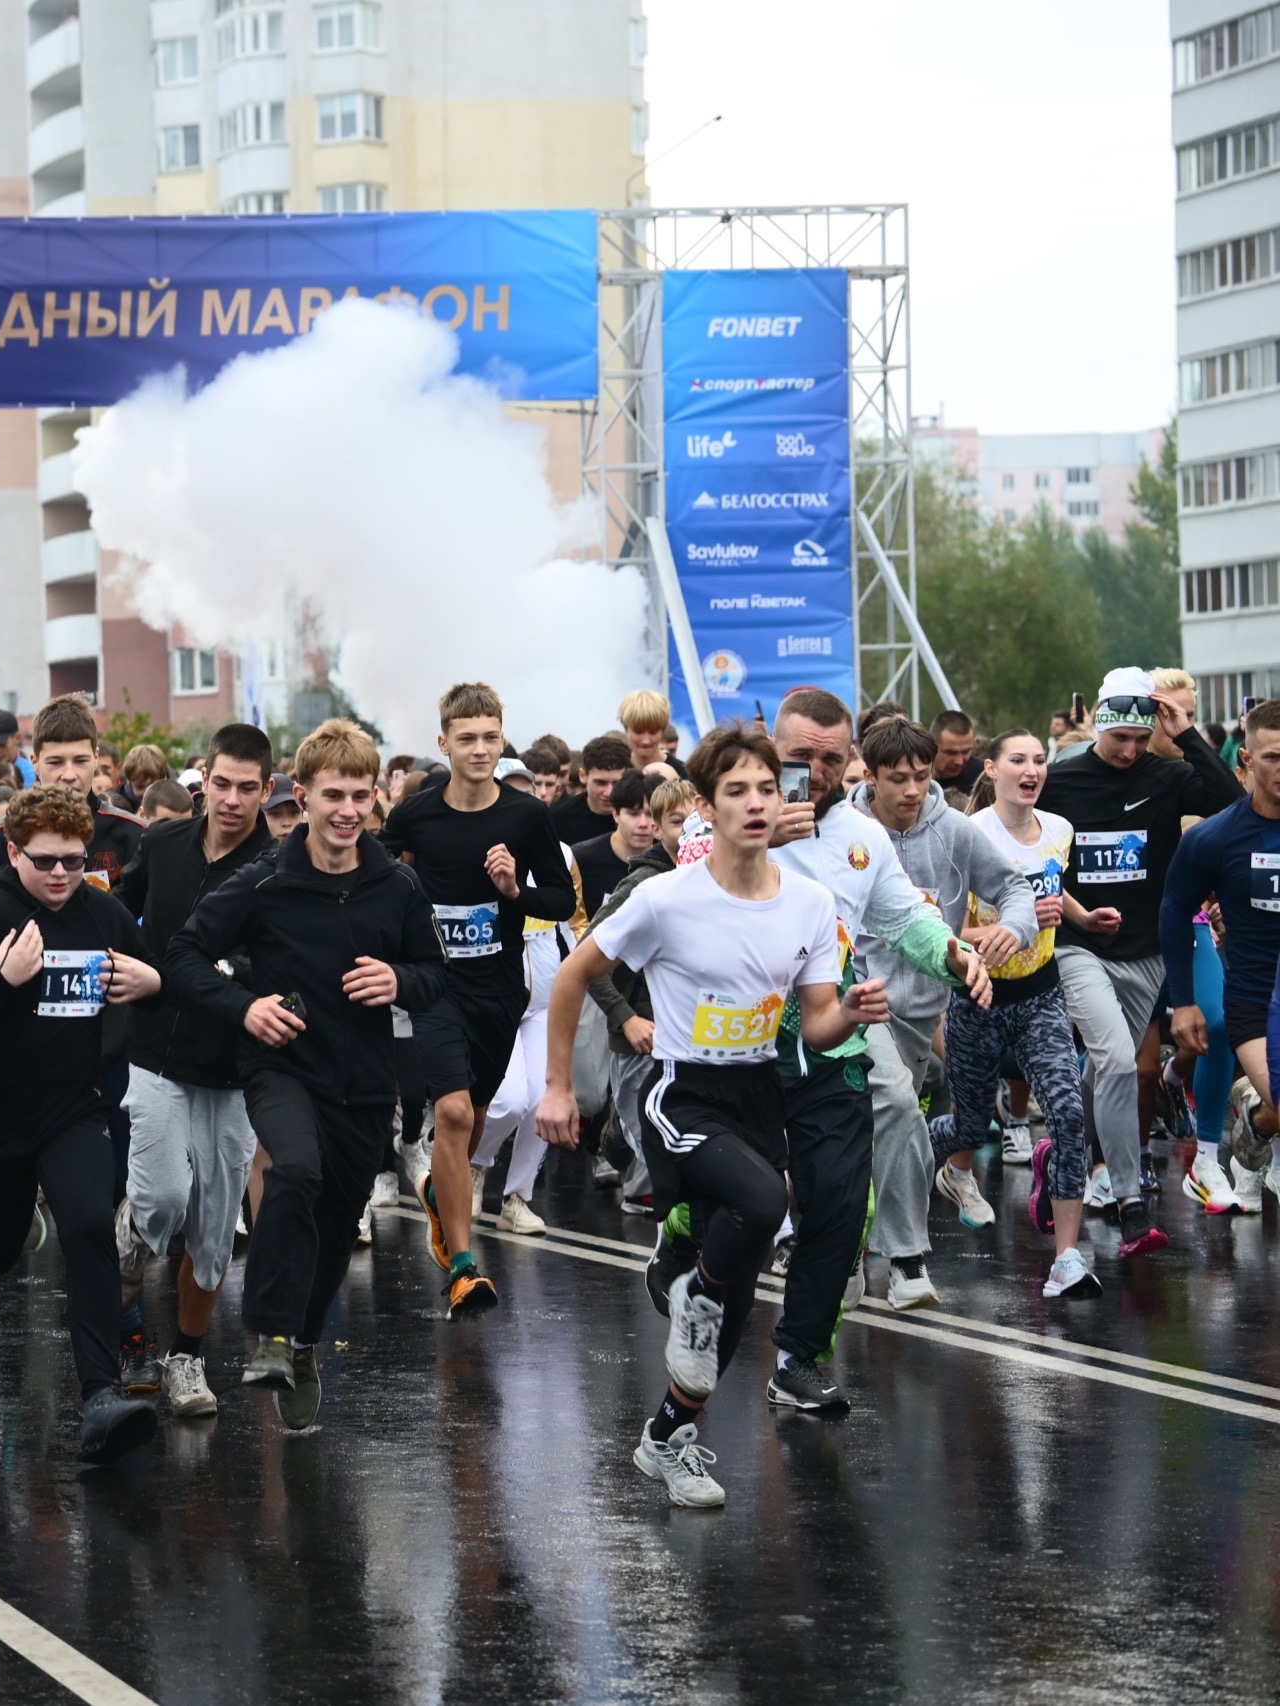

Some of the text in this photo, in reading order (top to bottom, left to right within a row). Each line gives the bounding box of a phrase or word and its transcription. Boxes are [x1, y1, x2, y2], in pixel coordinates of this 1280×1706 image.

[200, 283, 510, 336] МАРОН
[707, 316, 803, 338] FONBET
[687, 434, 725, 458] life
[721, 492, 829, 510] БЕЛГОССТРАХ
[686, 543, 760, 560] Savlukov
[710, 597, 807, 610] ПОЛЕ КВЕТАК
[1094, 848, 1138, 867] 1176
[1033, 873, 1061, 897] 299
[441, 922, 494, 942] 1405
[704, 1009, 777, 1041] 3521
